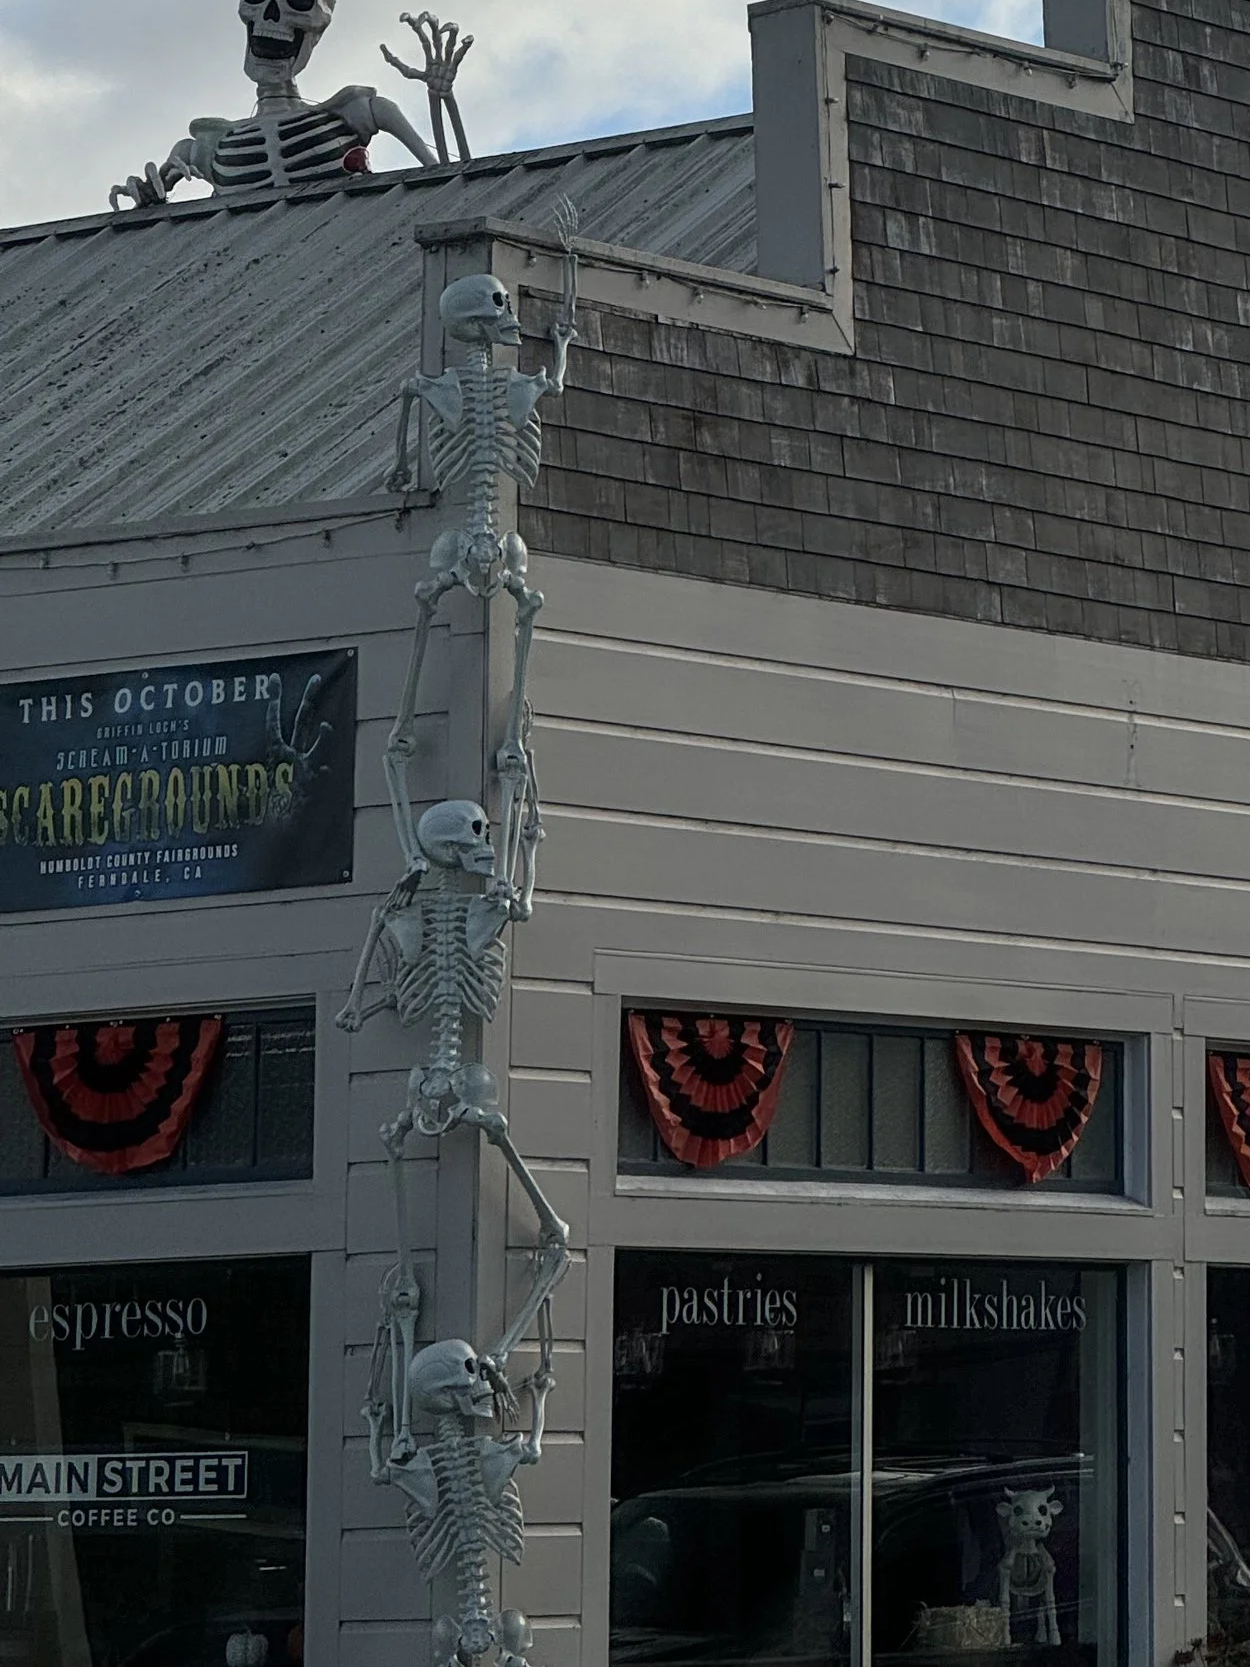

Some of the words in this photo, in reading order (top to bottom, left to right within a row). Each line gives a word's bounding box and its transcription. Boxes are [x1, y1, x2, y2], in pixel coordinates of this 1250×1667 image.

[19, 692, 94, 724] THIS
[113, 674, 271, 714] OCTOBER
[96, 723, 143, 739] GRIFFIN
[56, 736, 228, 771] SCREAM-A-TORIUM
[40, 856, 101, 874] HUMBOLDT
[106, 852, 151, 868] COUNTY
[156, 844, 239, 863] FAIRGROUNDS
[78, 868, 171, 889] FERNDALE,
[183, 865, 202, 880] CA
[661, 1273, 798, 1334] pastries
[905, 1277, 1087, 1332] milkshakes
[29, 1297, 207, 1351] espresso
[0, 1461, 89, 1495] MAIN
[102, 1458, 242, 1494] STREET
[57, 1508, 138, 1527] COFFEE
[146, 1508, 176, 1526] CO
